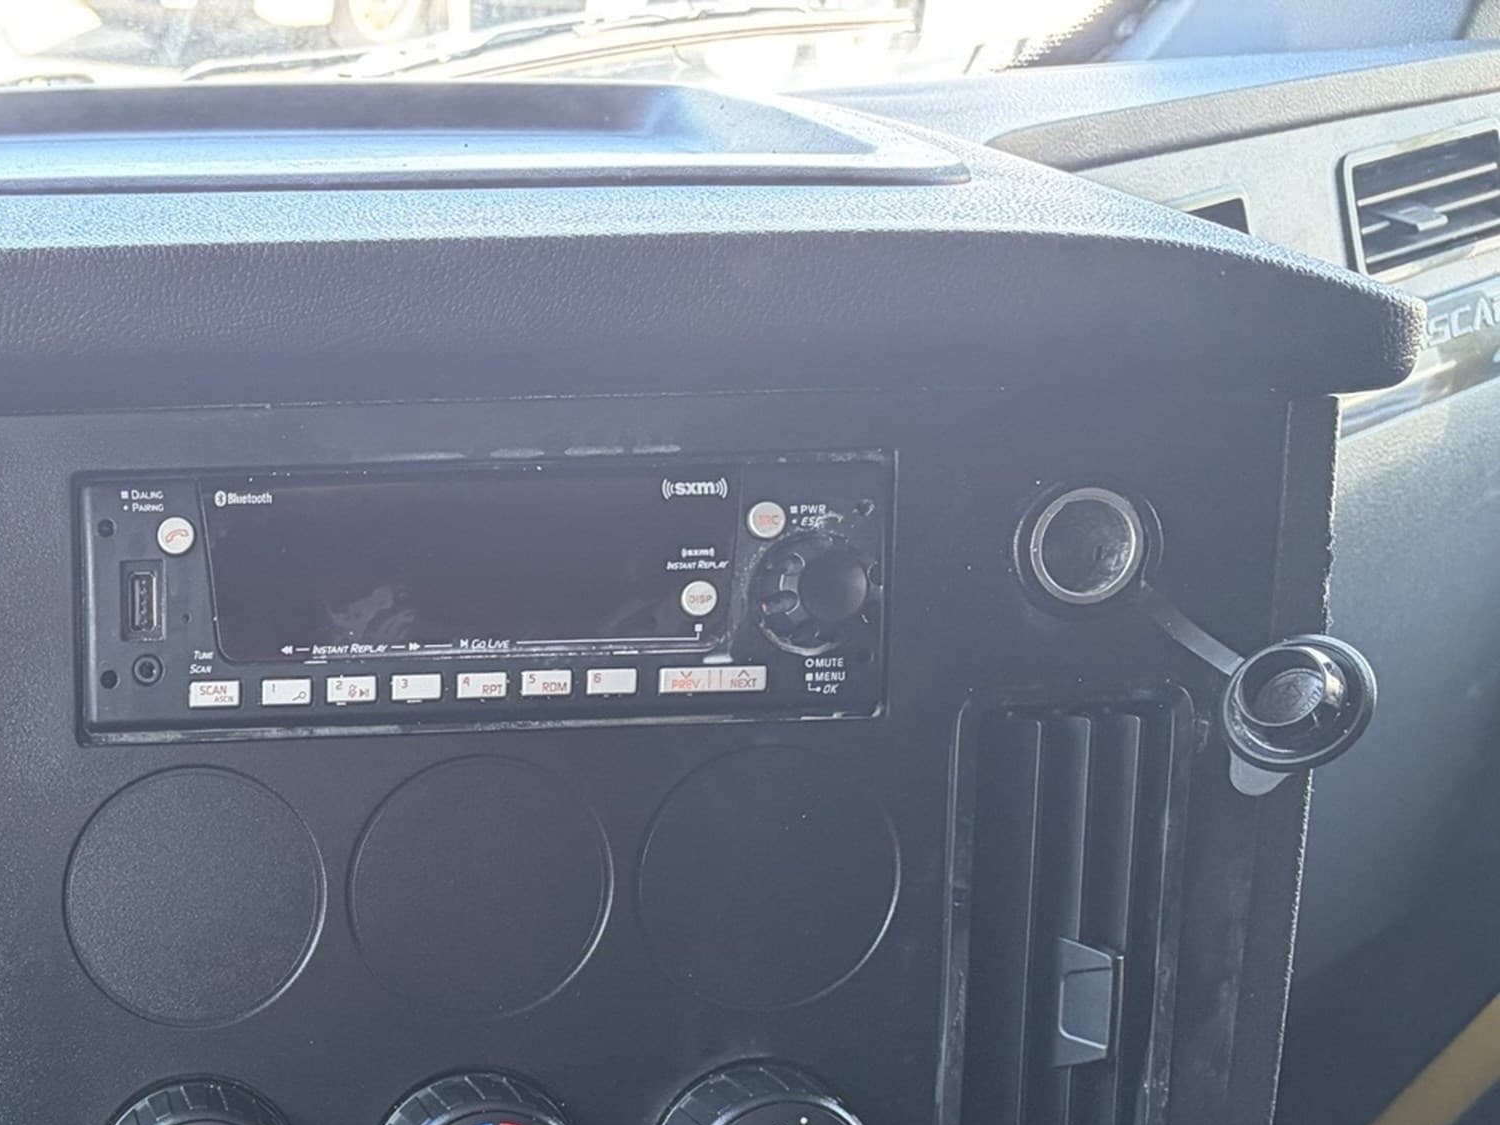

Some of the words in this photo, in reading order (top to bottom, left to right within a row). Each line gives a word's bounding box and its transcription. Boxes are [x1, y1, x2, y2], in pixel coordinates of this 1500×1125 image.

[1427, 297, 1500, 347] SCA
[131, 490, 164, 500] DIALING
[227, 492, 273, 505] Bluetooth
[132, 503, 164, 512] PAIRING
[800, 504, 827, 514] PWR
[666, 561, 697, 571] INSTANT
[697, 560, 729, 570] REPLAY
[312, 645, 349, 655] INSTANT
[350, 643, 388, 653] REPLAY
[488, 639, 510, 649] LIVE
[815, 658, 844, 668] MUTE
[189, 664, 213, 674] SCAN
[528, 674, 536, 684] 5
[815, 672, 845, 681] MENU
[542, 682, 568, 692] RDM
[671, 678, 701, 689] PREV
[730, 677, 758, 688] NEXT
[199, 685, 227, 695] SCAN
[482, 684, 503, 694] RPT
[822, 684, 840, 694] OK
